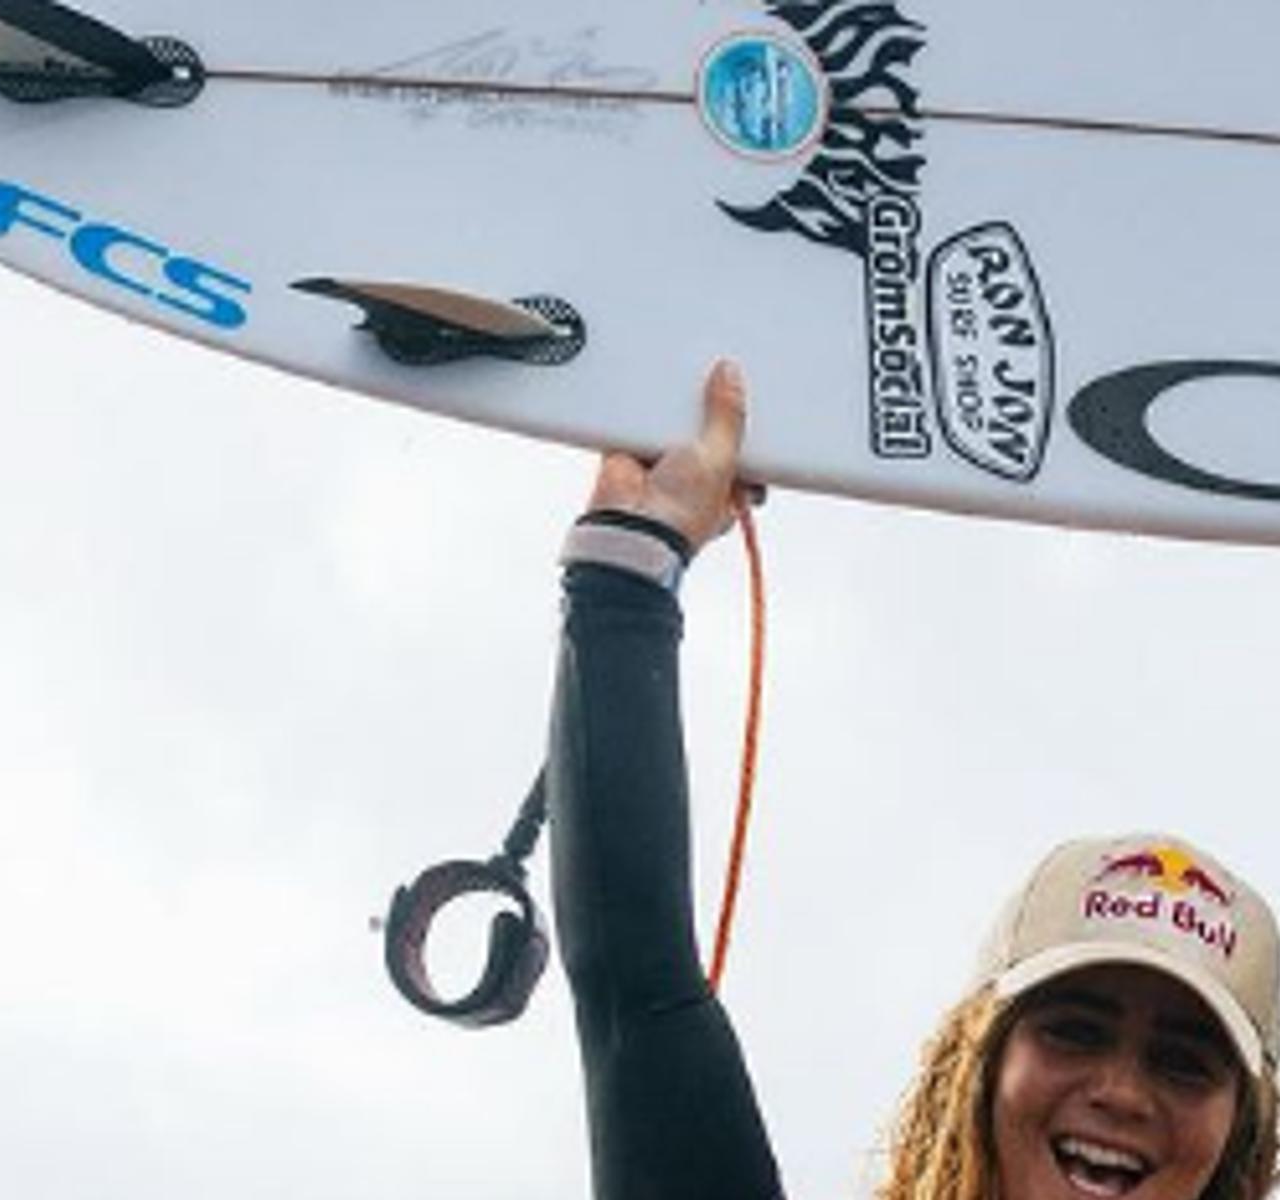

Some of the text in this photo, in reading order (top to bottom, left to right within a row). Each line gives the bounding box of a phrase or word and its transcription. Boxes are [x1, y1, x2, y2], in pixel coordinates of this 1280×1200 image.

[873, 201, 922, 450] GromSocial
[947, 271, 984, 432] SURF SHOP
[969, 246, 1036, 464] RON JON
[1084, 890, 1237, 960] Red Bull
